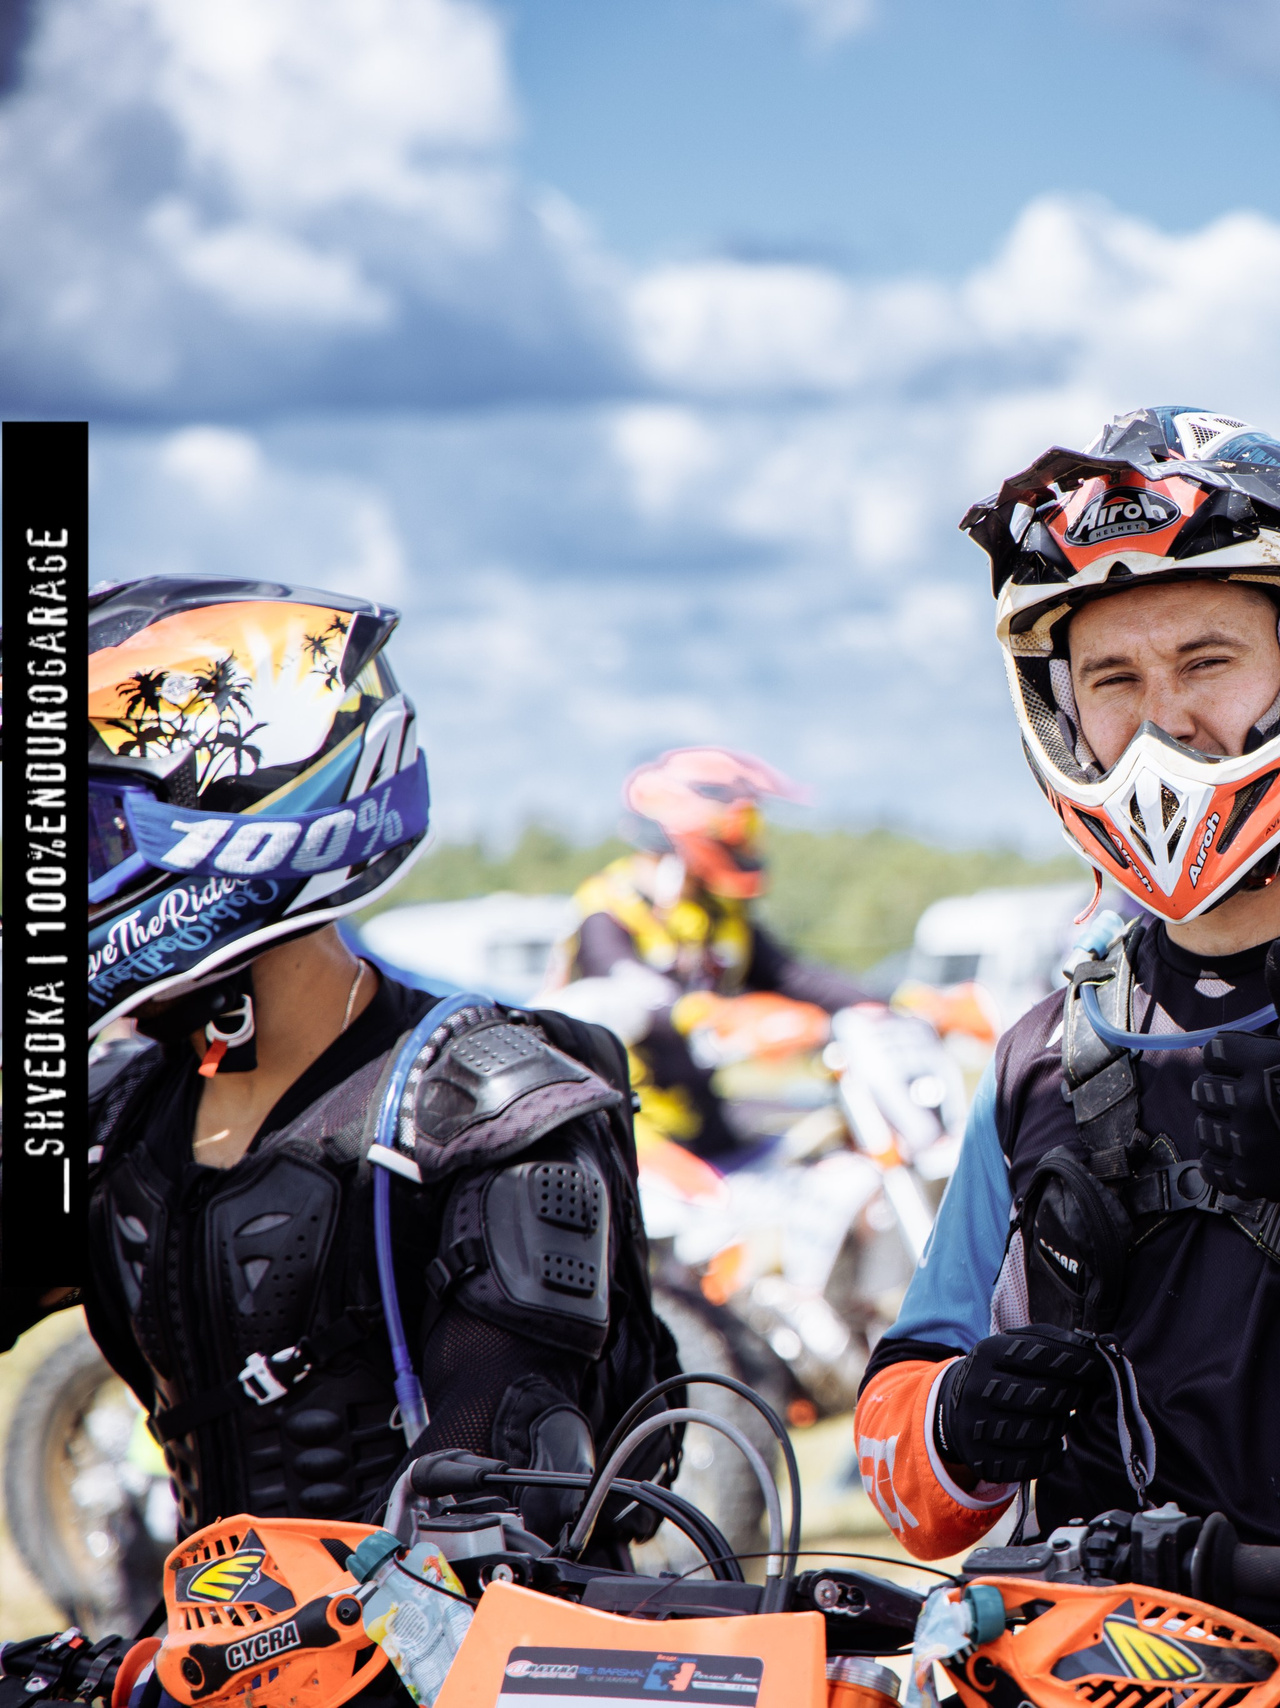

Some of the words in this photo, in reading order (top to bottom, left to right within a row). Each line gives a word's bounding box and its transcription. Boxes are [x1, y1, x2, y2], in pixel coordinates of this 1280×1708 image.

[1096, 524, 1140, 537] HELMET
[161, 786, 404, 875] 100%
[226, 1621, 300, 1671] CYCRA
